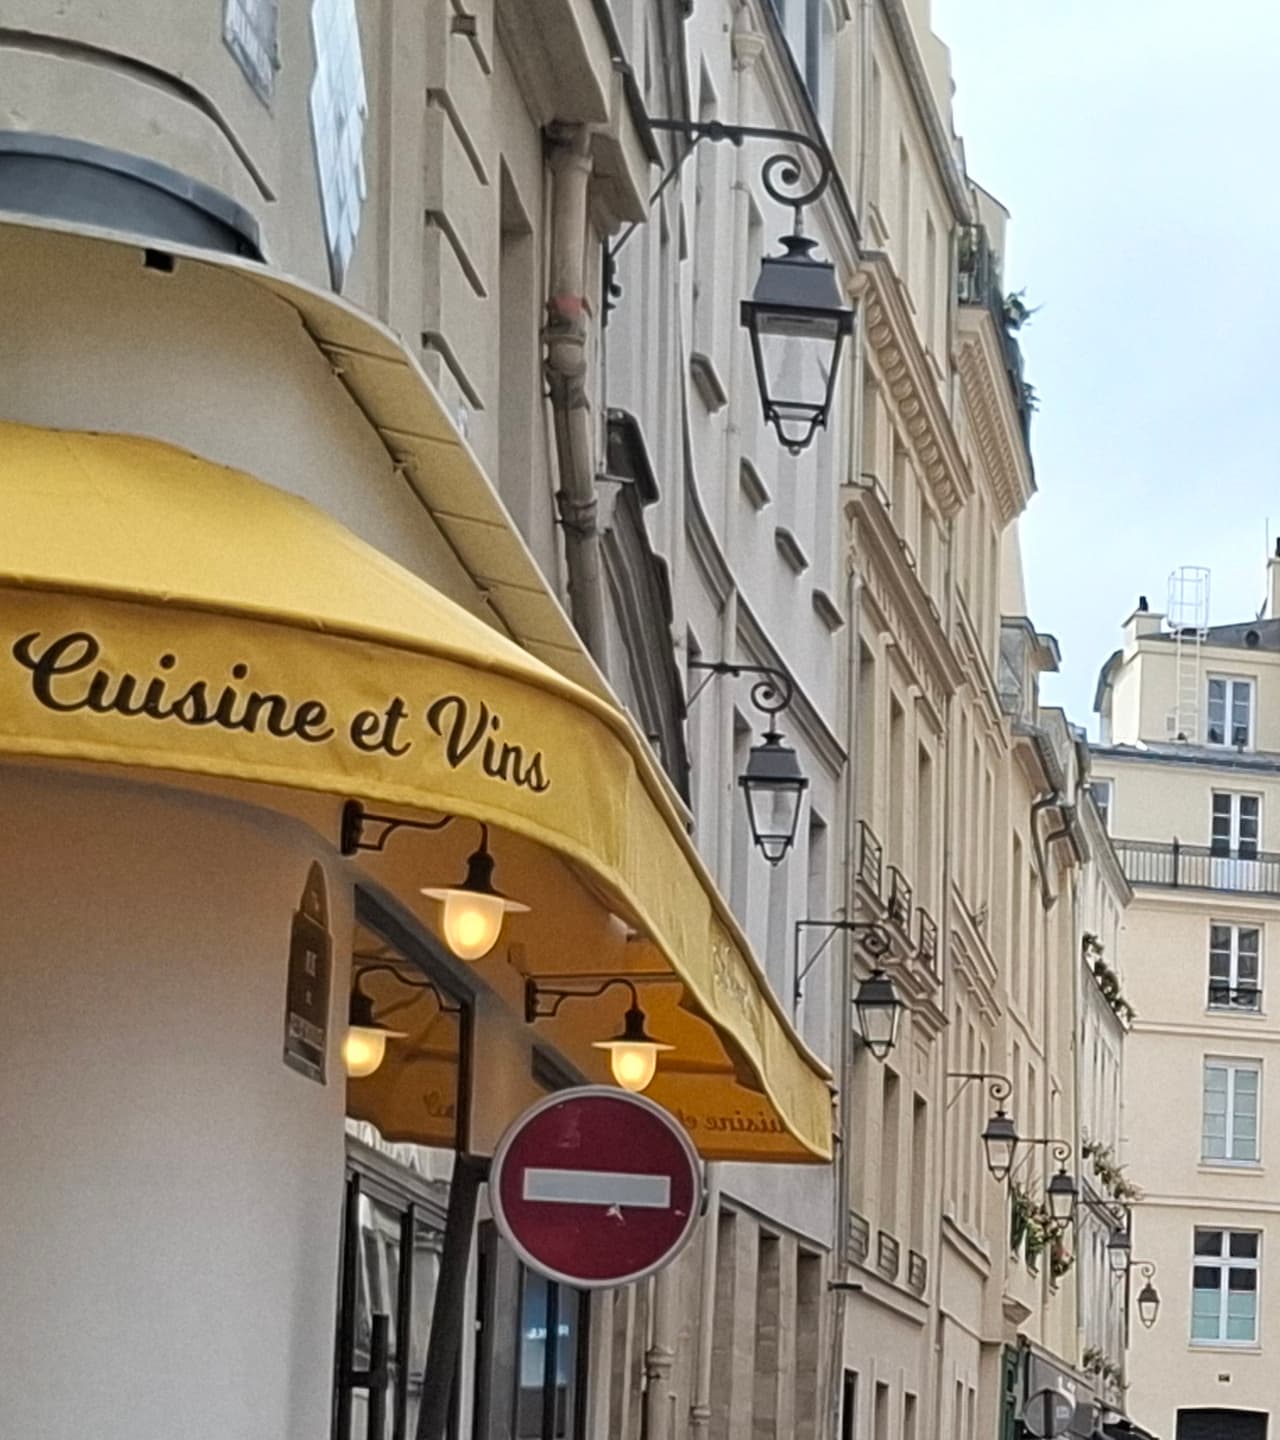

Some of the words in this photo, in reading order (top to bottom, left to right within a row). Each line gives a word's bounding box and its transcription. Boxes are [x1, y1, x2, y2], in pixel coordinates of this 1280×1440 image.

[12, 631, 335, 742] Cuisine
[350, 696, 412, 757] et
[426, 695, 550, 792] Vins
